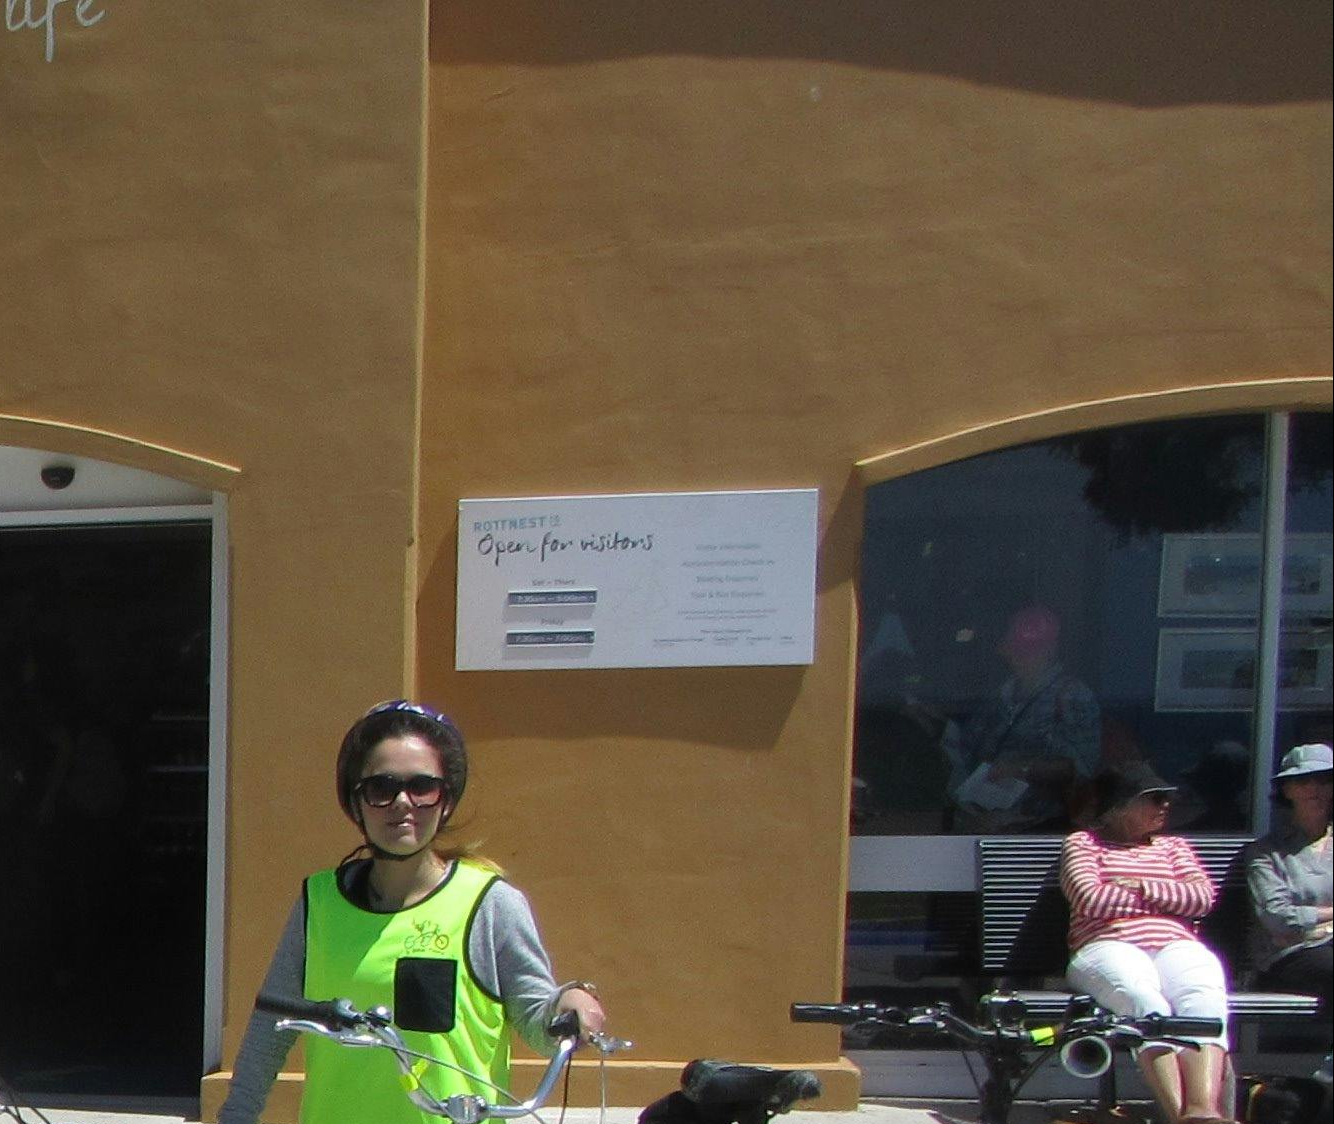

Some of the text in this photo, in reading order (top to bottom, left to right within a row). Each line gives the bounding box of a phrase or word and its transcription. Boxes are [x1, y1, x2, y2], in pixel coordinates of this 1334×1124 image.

[474, 516, 547, 532] ROTTNEST
[478, 531, 654, 566] Open for visitors
